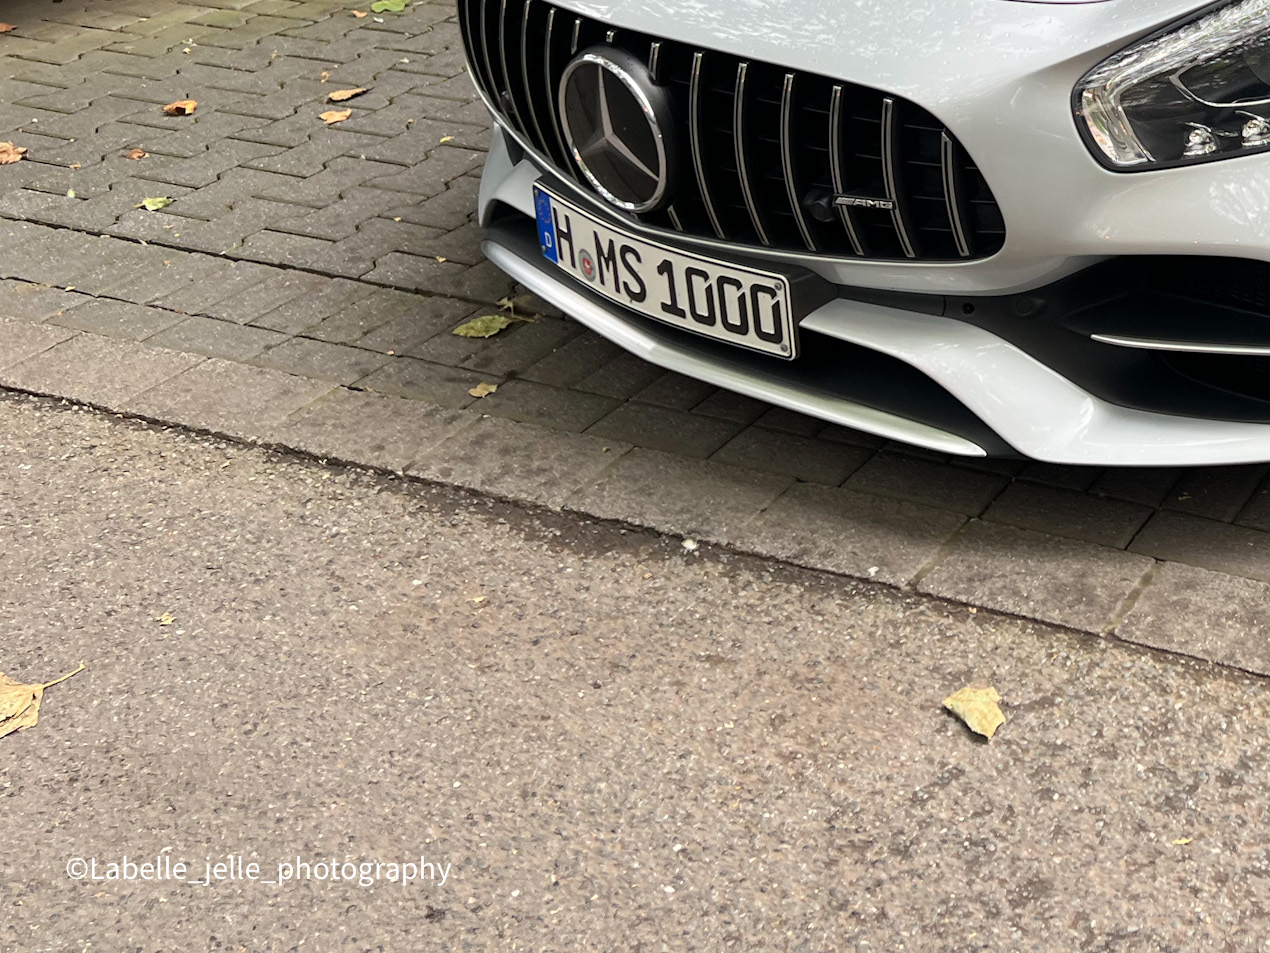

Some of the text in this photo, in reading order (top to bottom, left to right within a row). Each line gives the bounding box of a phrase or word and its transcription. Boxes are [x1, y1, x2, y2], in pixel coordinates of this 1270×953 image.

[853, 198, 893, 209] AMG
[544, 231, 552, 248] D
[552, 206, 783, 345] H MS 1000
